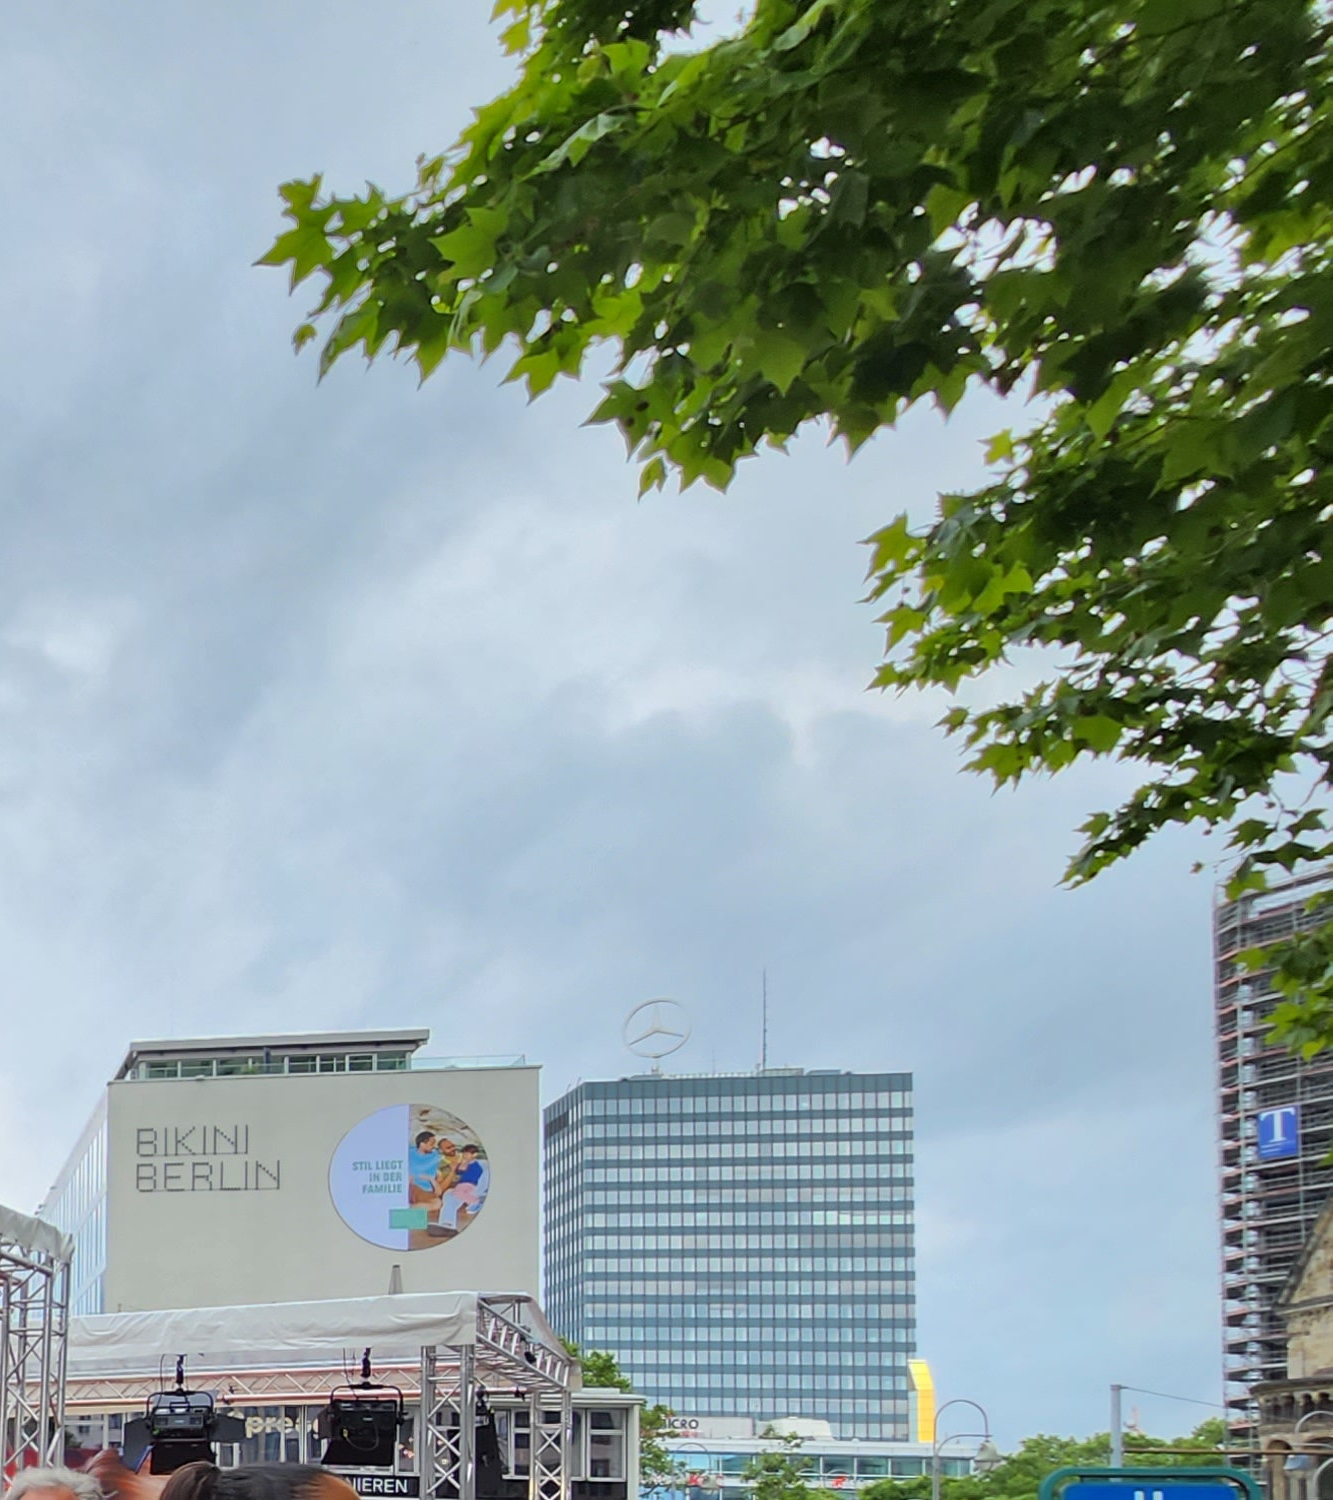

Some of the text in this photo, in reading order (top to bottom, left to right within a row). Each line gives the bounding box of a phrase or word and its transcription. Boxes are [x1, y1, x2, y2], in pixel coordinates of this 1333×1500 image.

[136, 1124, 248, 1157] BIKINI
[352, 1160, 403, 1171] STIL LIEGT
[136, 1160, 280, 1192] BERLIN
[369, 1172, 402, 1182] IN DER
[362, 1184, 403, 1194] FAMILIE
